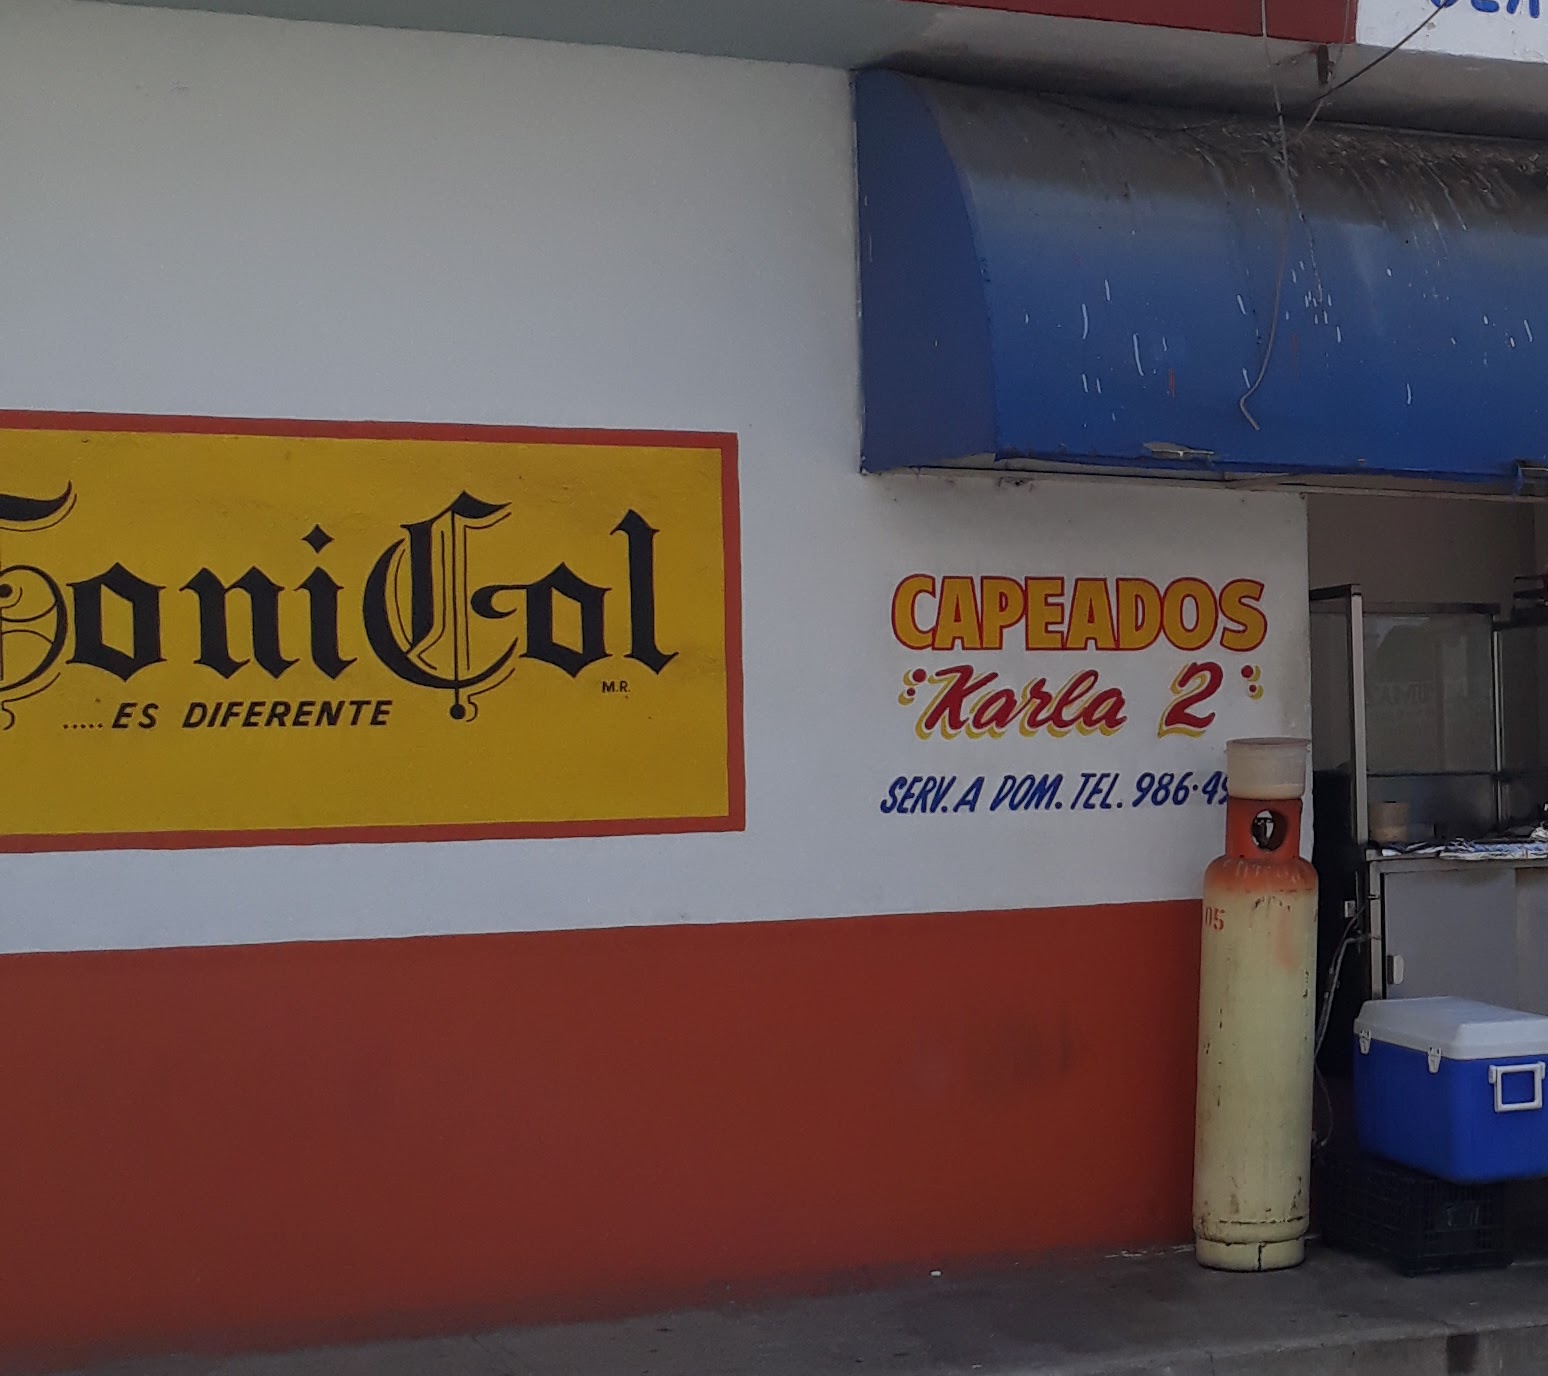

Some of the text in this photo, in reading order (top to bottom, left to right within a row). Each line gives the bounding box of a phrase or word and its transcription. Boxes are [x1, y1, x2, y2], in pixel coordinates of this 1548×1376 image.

[891, 573, 1268, 651] CAPEADOS
[602, 680, 631, 693] M.R.
[914, 661, 1224, 740] Karla 2
[183, 699, 394, 729] DIFERENTE
[990, 774, 1062, 812] DOM.
[1071, 773, 1122, 810] TEL.
